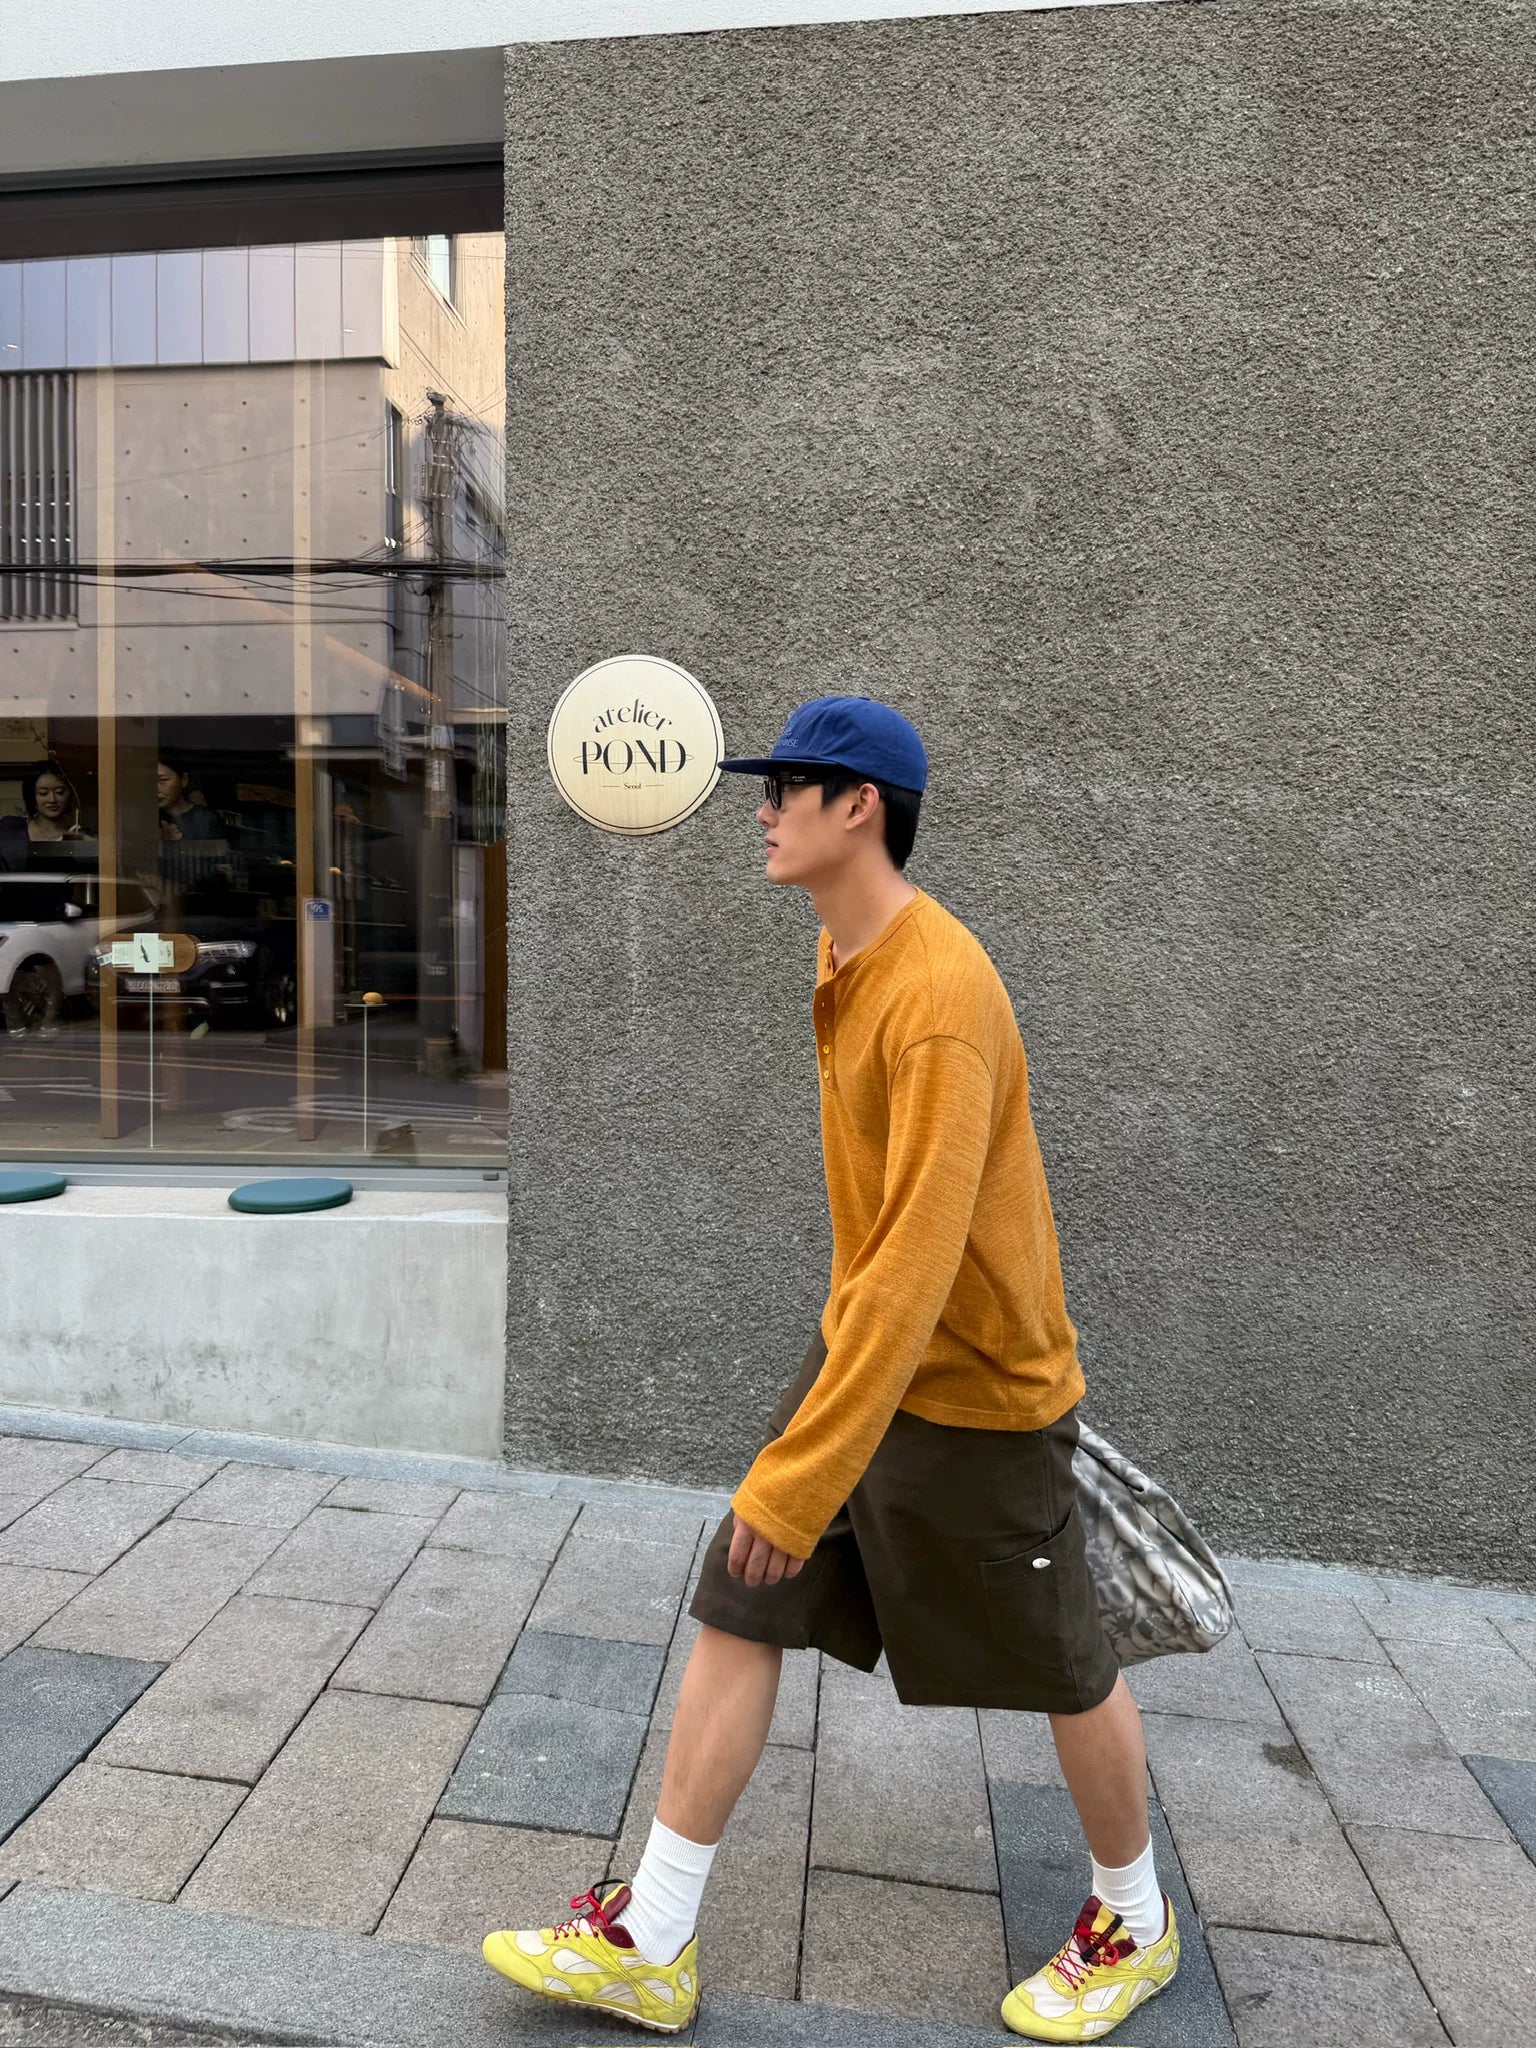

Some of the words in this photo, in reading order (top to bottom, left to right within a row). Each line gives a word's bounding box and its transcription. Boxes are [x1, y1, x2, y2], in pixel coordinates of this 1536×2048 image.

[592, 698, 672, 734] atelier
[581, 739, 687, 775] POND
[623, 782, 642, 790] Seoul
